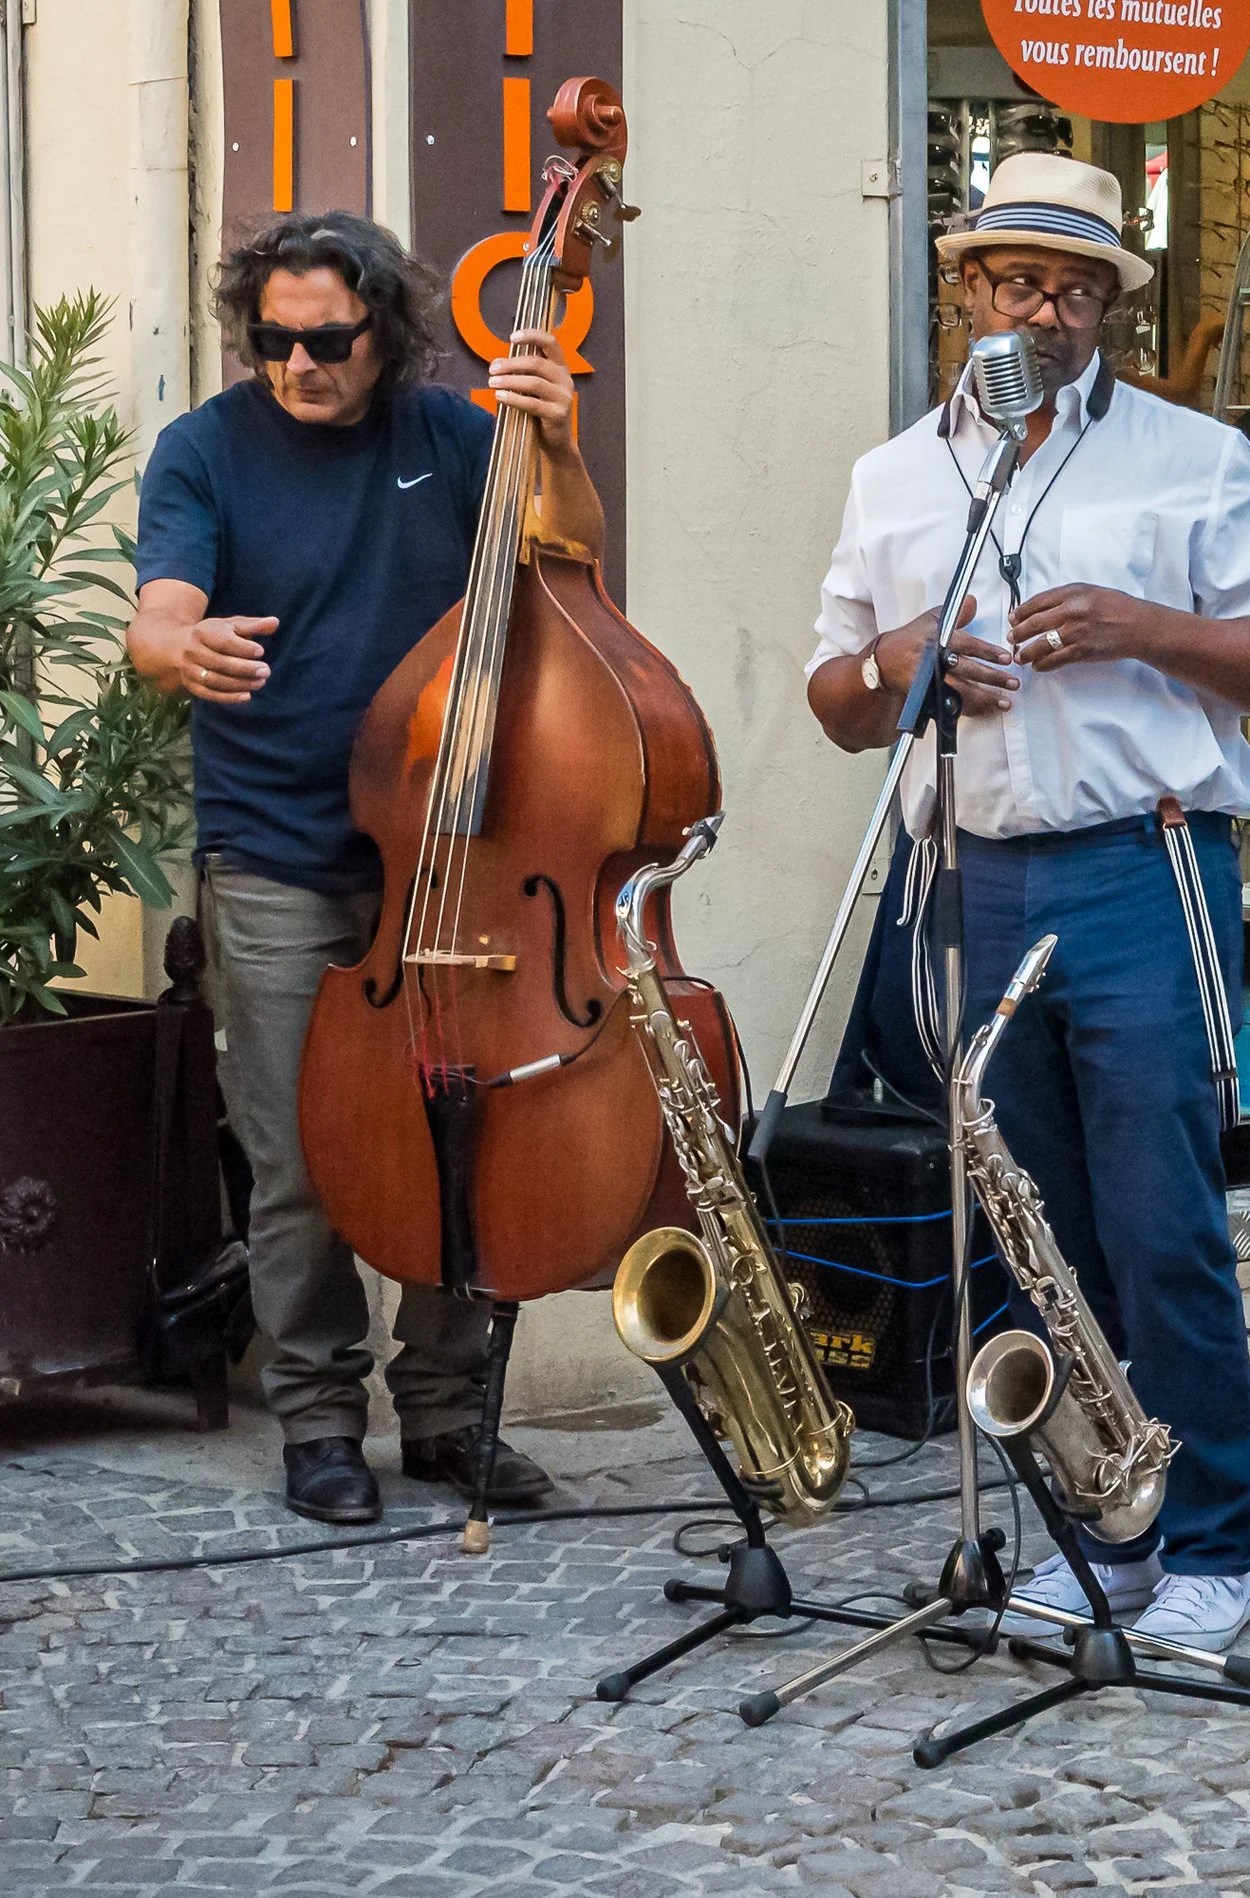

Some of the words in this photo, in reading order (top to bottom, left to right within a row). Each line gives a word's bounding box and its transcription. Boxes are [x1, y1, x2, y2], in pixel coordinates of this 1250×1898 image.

[1087, 0, 1116, 20] les
[1120, 0, 1223, 29] mutuelles
[1020, 39, 1070, 65] vous
[1074, 38, 1207, 76] remboursent
